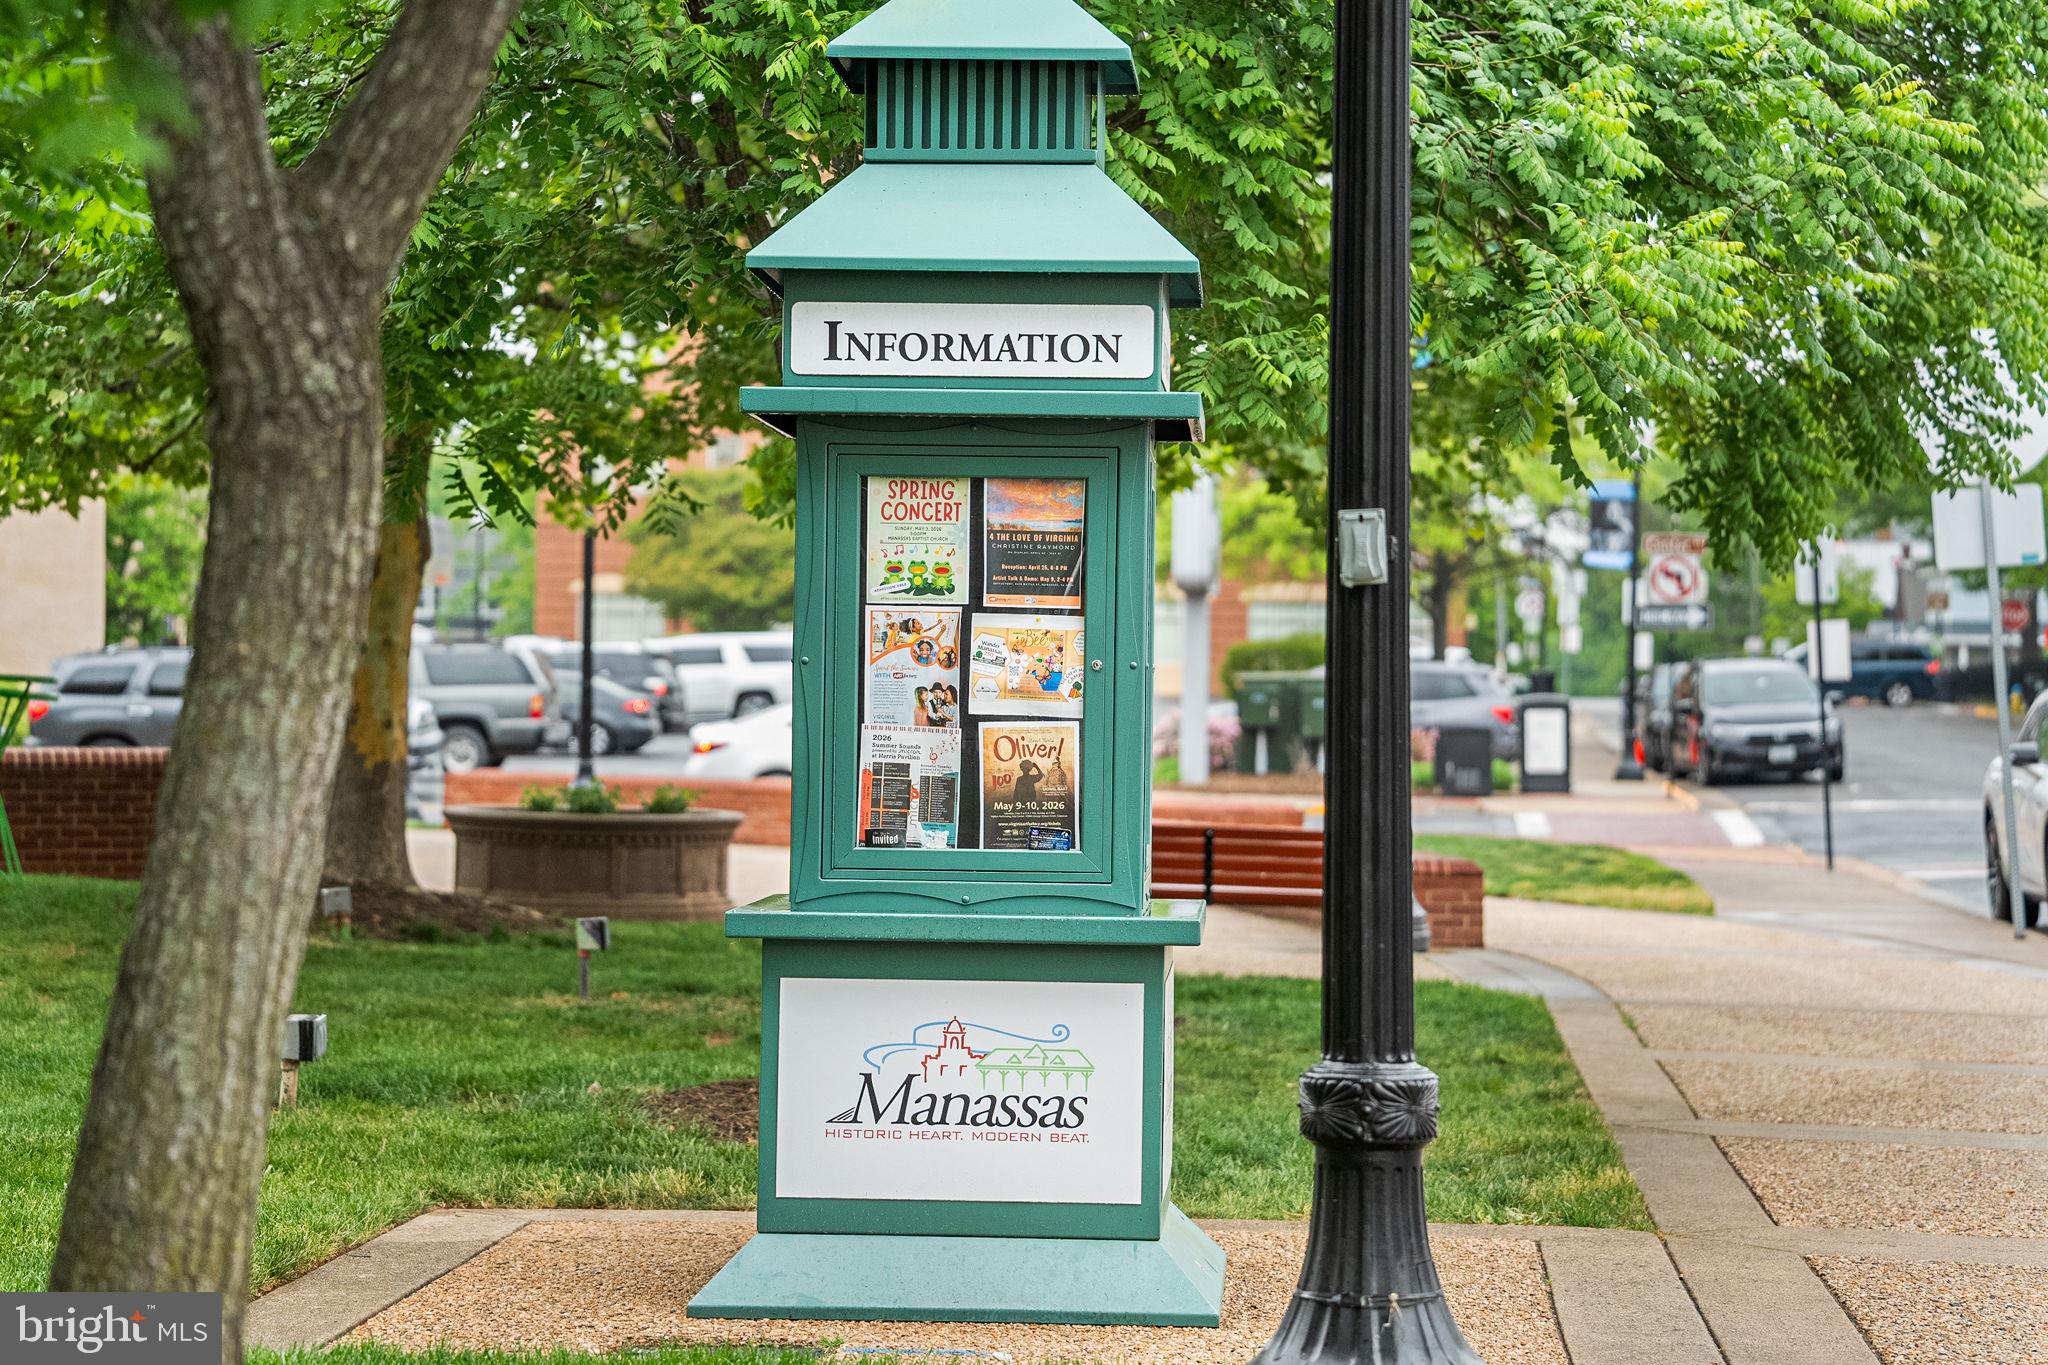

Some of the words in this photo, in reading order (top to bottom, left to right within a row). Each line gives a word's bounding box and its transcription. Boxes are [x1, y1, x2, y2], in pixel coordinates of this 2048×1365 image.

[823, 320, 1123, 363] INFORMATION
[888, 480, 955, 500] SPRING
[881, 502, 962, 521] CONCERT
[1045, 534, 1079, 542] VIRGINIA
[994, 735, 1064, 762] Oliver!
[994, 802, 1014, 812] May
[1016, 802, 1039, 810] 9-10,
[1042, 802, 1065, 810] 2026
[826, 1072, 1088, 1129] Manassas
[825, 1128, 902, 1140] HISTORIC
[909, 1130, 964, 1141] HEART.
[972, 1131, 1042, 1142] MODERN
[1050, 1132, 1090, 1143] BEAT.
